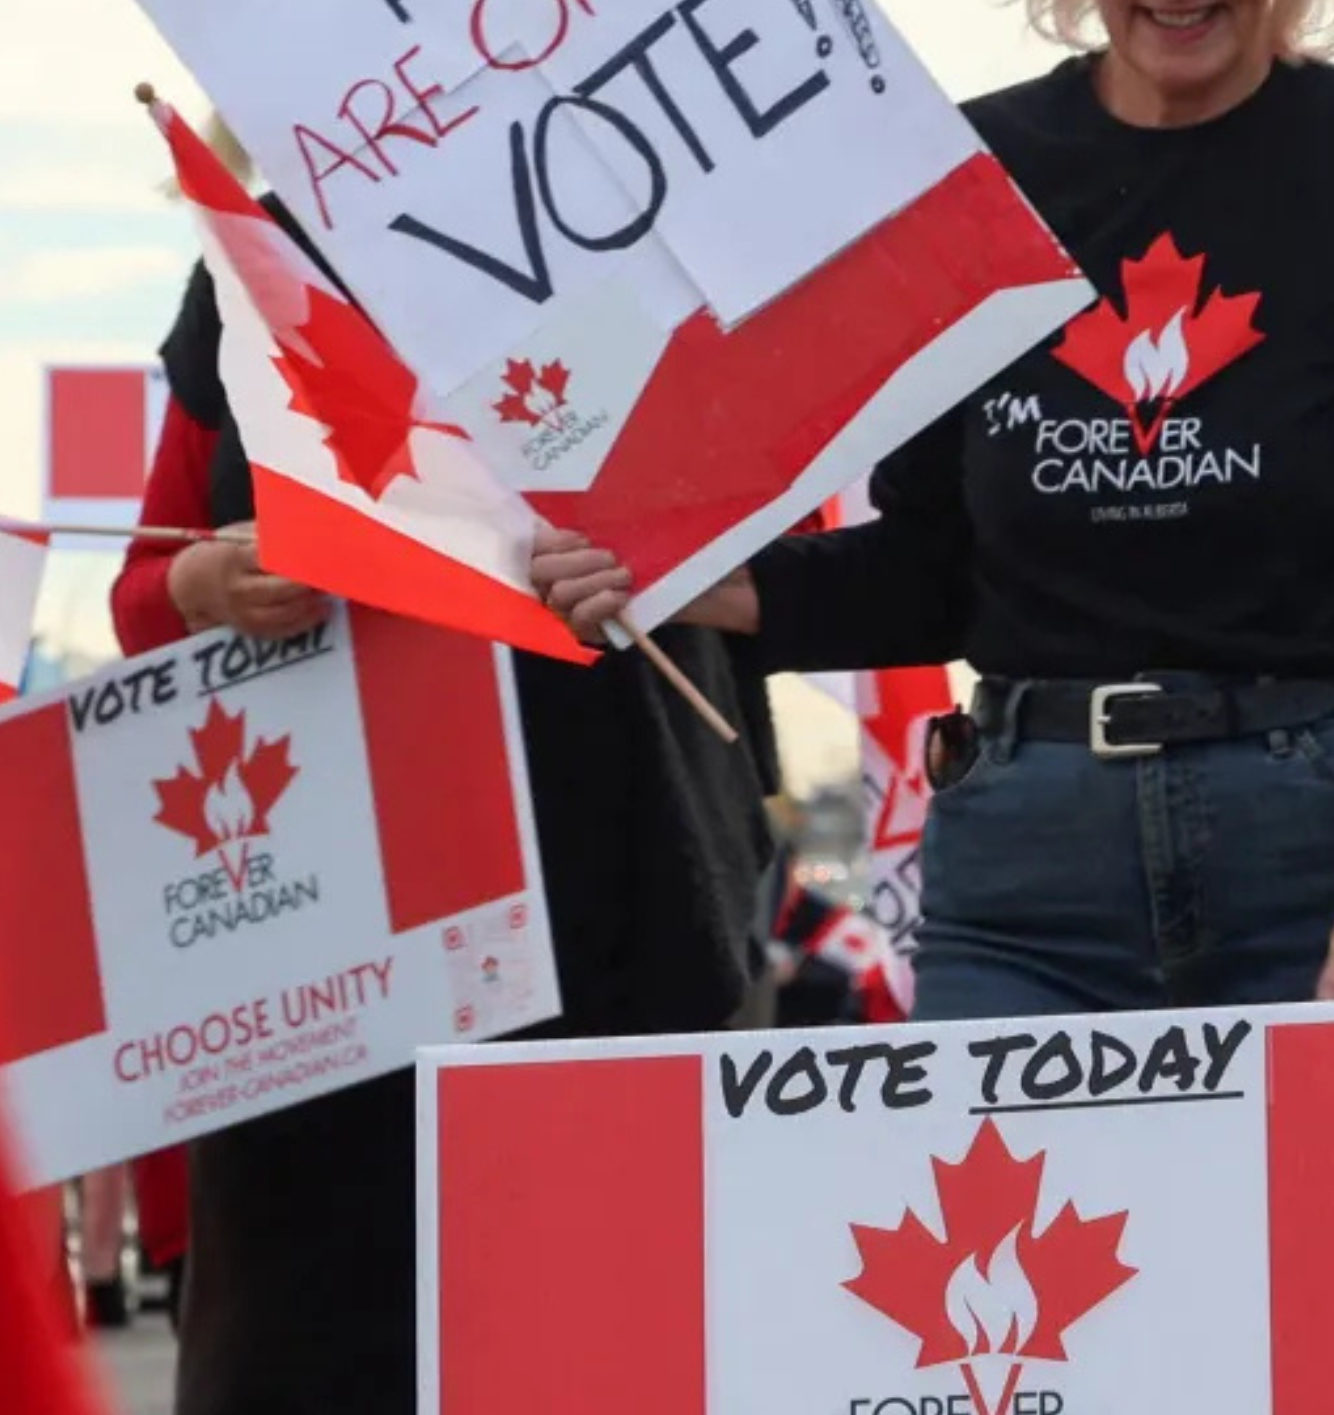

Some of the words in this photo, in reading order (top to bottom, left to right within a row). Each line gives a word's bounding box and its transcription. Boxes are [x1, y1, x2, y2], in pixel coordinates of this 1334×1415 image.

[289, 45, 479, 229] ARE
[982, 392, 1042, 436] I'M
[1034, 400, 1202, 456] FOREVER
[1031, 443, 1261, 492] CANADIAN
[69, 658, 178, 733] VOTE
[163, 842, 276, 914] FOREVER
[170, 872, 319, 948] CANADIAN
[114, 998, 274, 1082] CHOOSE
[280, 956, 394, 1028] UNITY
[720, 1040, 937, 1119] VOTE
[967, 1018, 1253, 1106] TODAY
